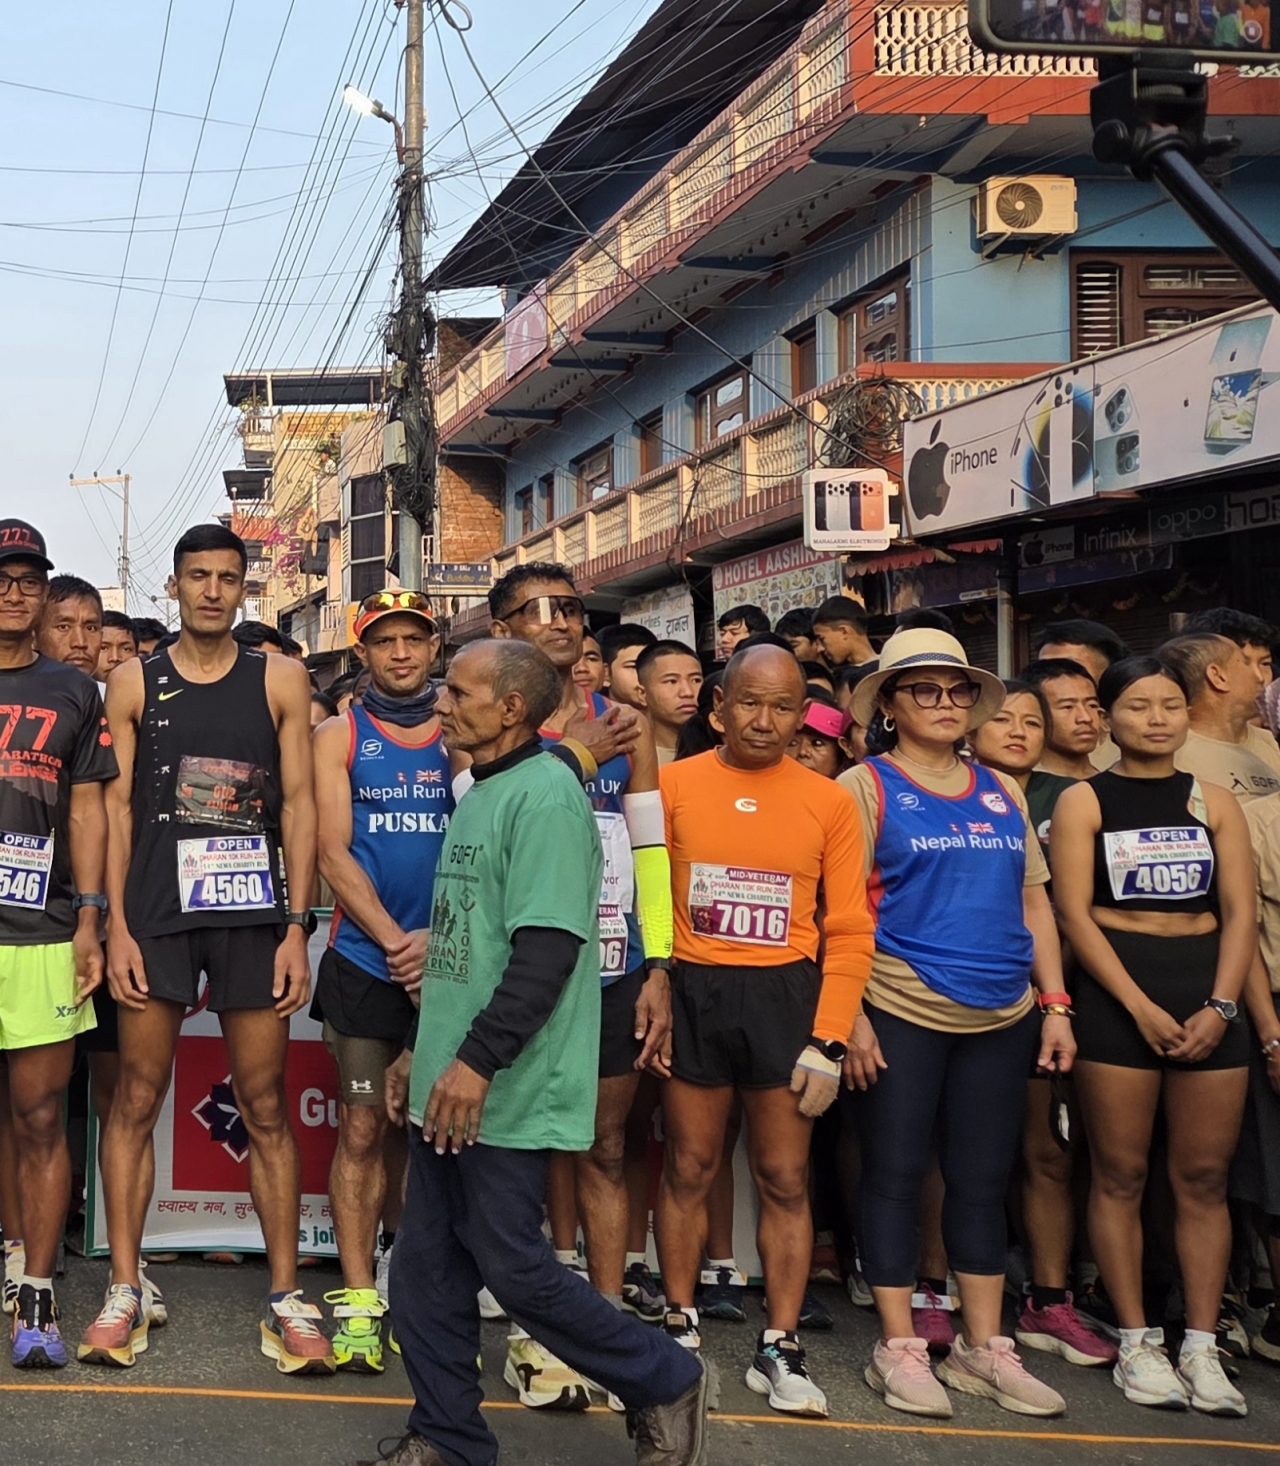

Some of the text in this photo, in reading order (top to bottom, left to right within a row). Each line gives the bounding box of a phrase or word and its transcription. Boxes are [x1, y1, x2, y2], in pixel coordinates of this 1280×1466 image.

[950, 444, 998, 475] iPhone
[1157, 501, 1217, 535] oppo
[0, 528, 30, 543] 777
[1083, 524, 1137, 553] Infinix
[1044, 538, 1073, 554] iPhone
[724, 557, 763, 586] HOTEL
[358, 784, 446, 802] Nepal Run
[368, 812, 450, 833] PUSKA
[4, 834, 39, 848] OPEN
[217, 839, 252, 850] OPEN
[910, 834, 1025, 853] Nepal Run UK
[1149, 830, 1190, 842] OPEN
[729, 869, 788, 883] MID-VETERAN
[1135, 863, 1203, 893] 4056
[201, 873, 264, 905] 4560
[711, 881, 740, 890] DHARAN
[742, 883, 755, 891] 10K
[756, 885, 772, 893] RUN
[727, 891, 745, 899] NEWA
[746, 893, 774, 902] CHARITY
[775, 896, 788, 904] RUN
[716, 903, 786, 939] 7016
[458, 921, 470, 976] 2026
[431, 957, 456, 973] RUN
[203, 1201, 227, 1215] मन,
